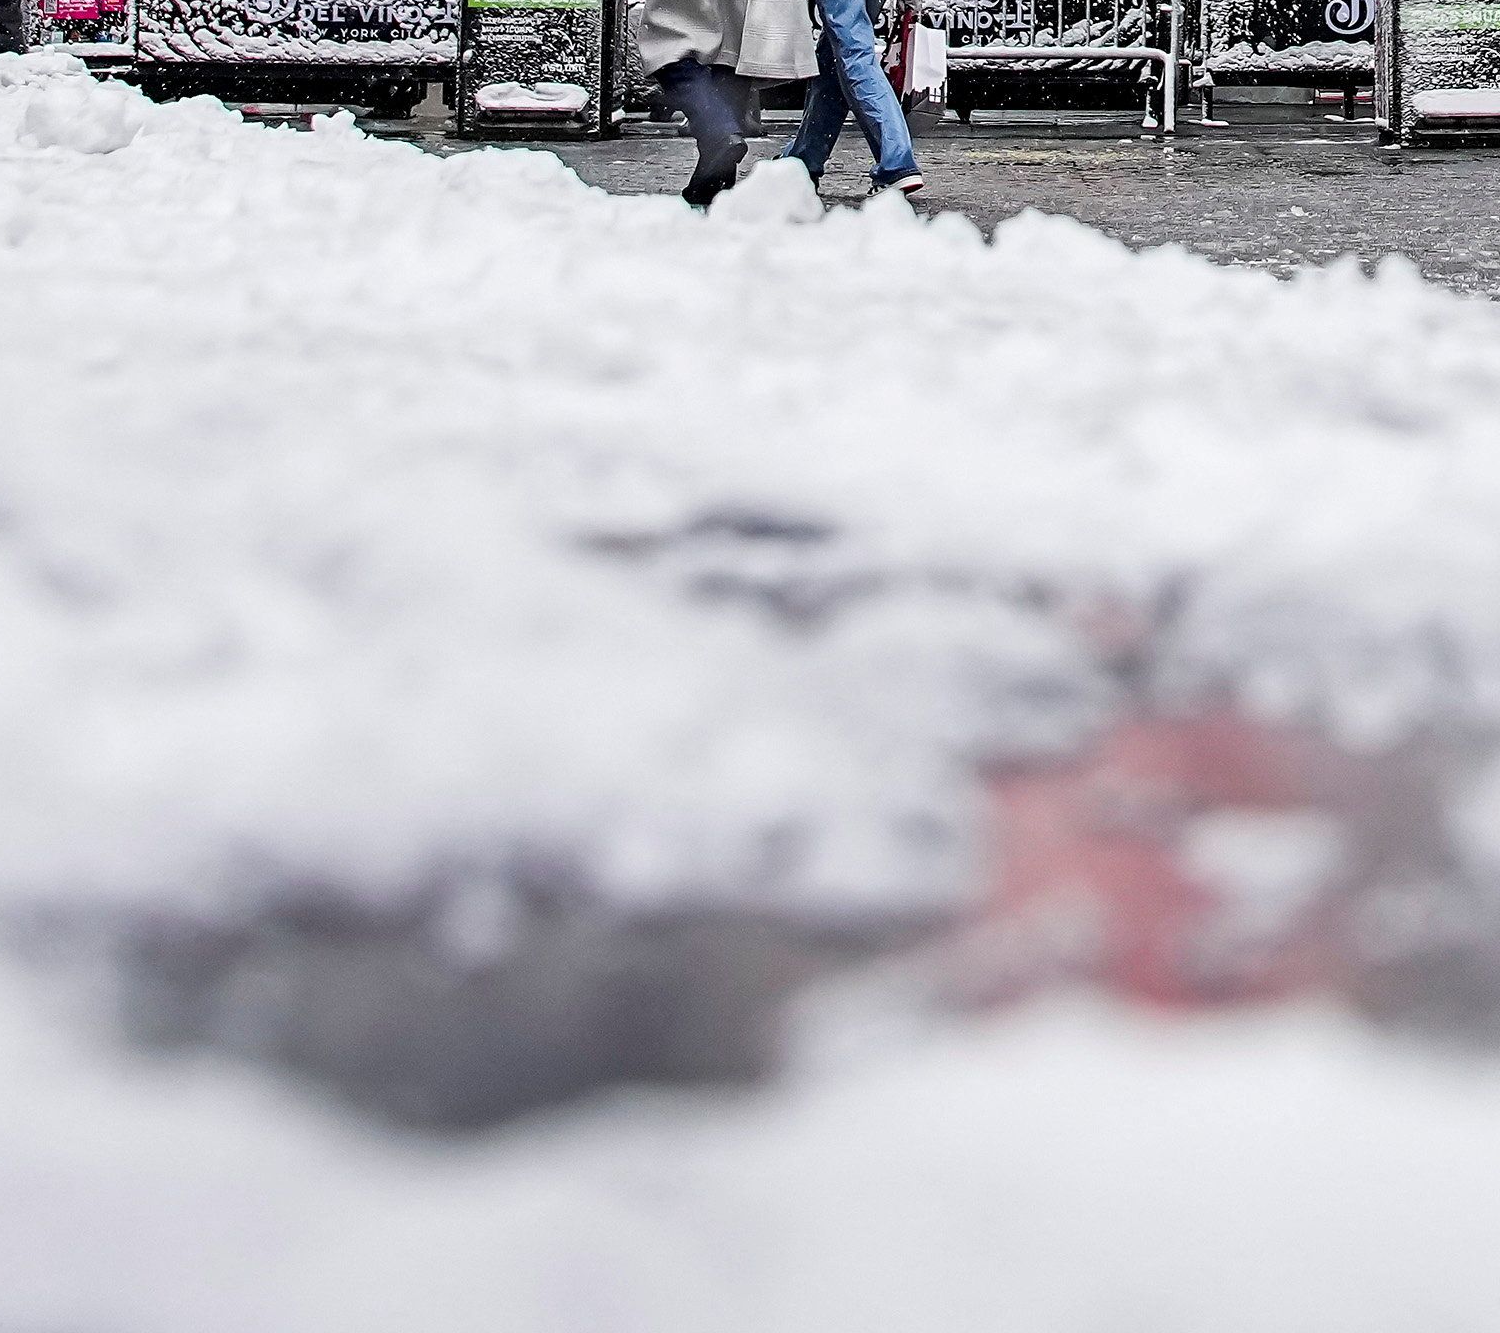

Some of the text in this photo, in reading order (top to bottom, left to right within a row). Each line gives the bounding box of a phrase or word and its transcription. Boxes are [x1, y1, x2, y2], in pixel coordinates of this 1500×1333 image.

[300, 4, 423, 24] DEL VINO
[929, 11, 993, 28] VINO
[341, 28, 379, 39] YORK
